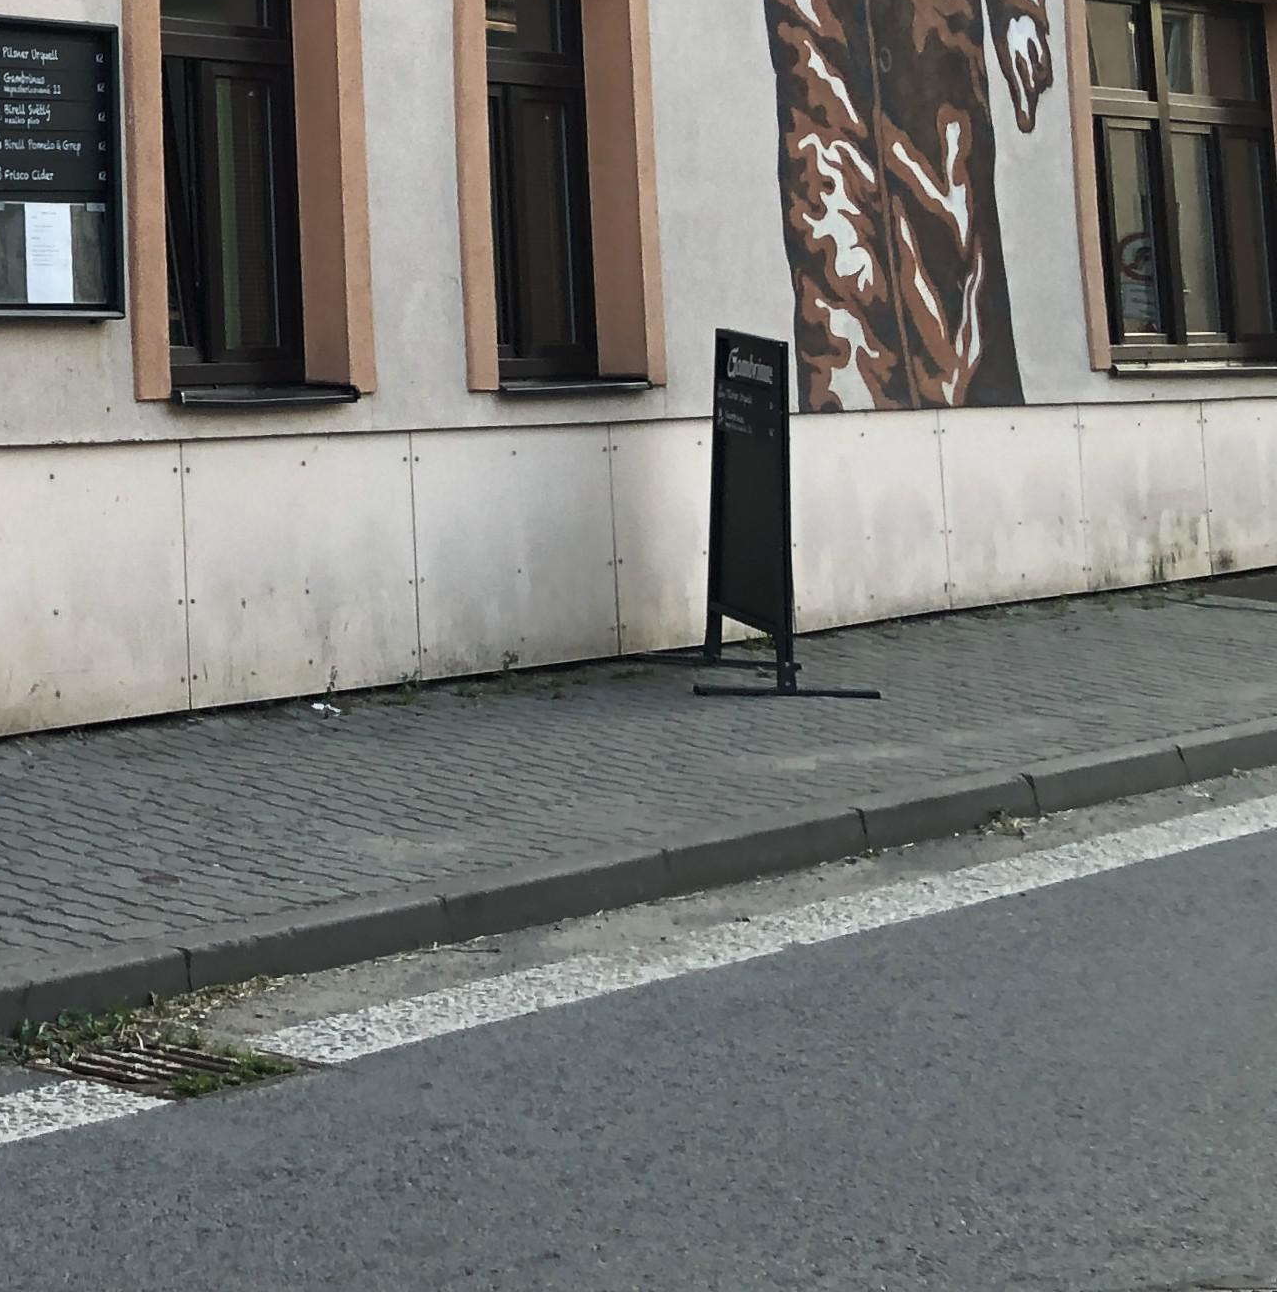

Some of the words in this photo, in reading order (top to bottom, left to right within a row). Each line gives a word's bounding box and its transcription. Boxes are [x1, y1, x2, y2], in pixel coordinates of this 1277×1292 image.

[2, 46, 29, 59] Pilsner
[31, 48, 59, 66] Urquell
[4, 104, 25, 115] Birell
[4, 139, 25, 149] Birell
[28, 139, 55, 150] Pomelo
[4, 170, 30, 181] Frisco
[31, 168, 54, 181] Cider
